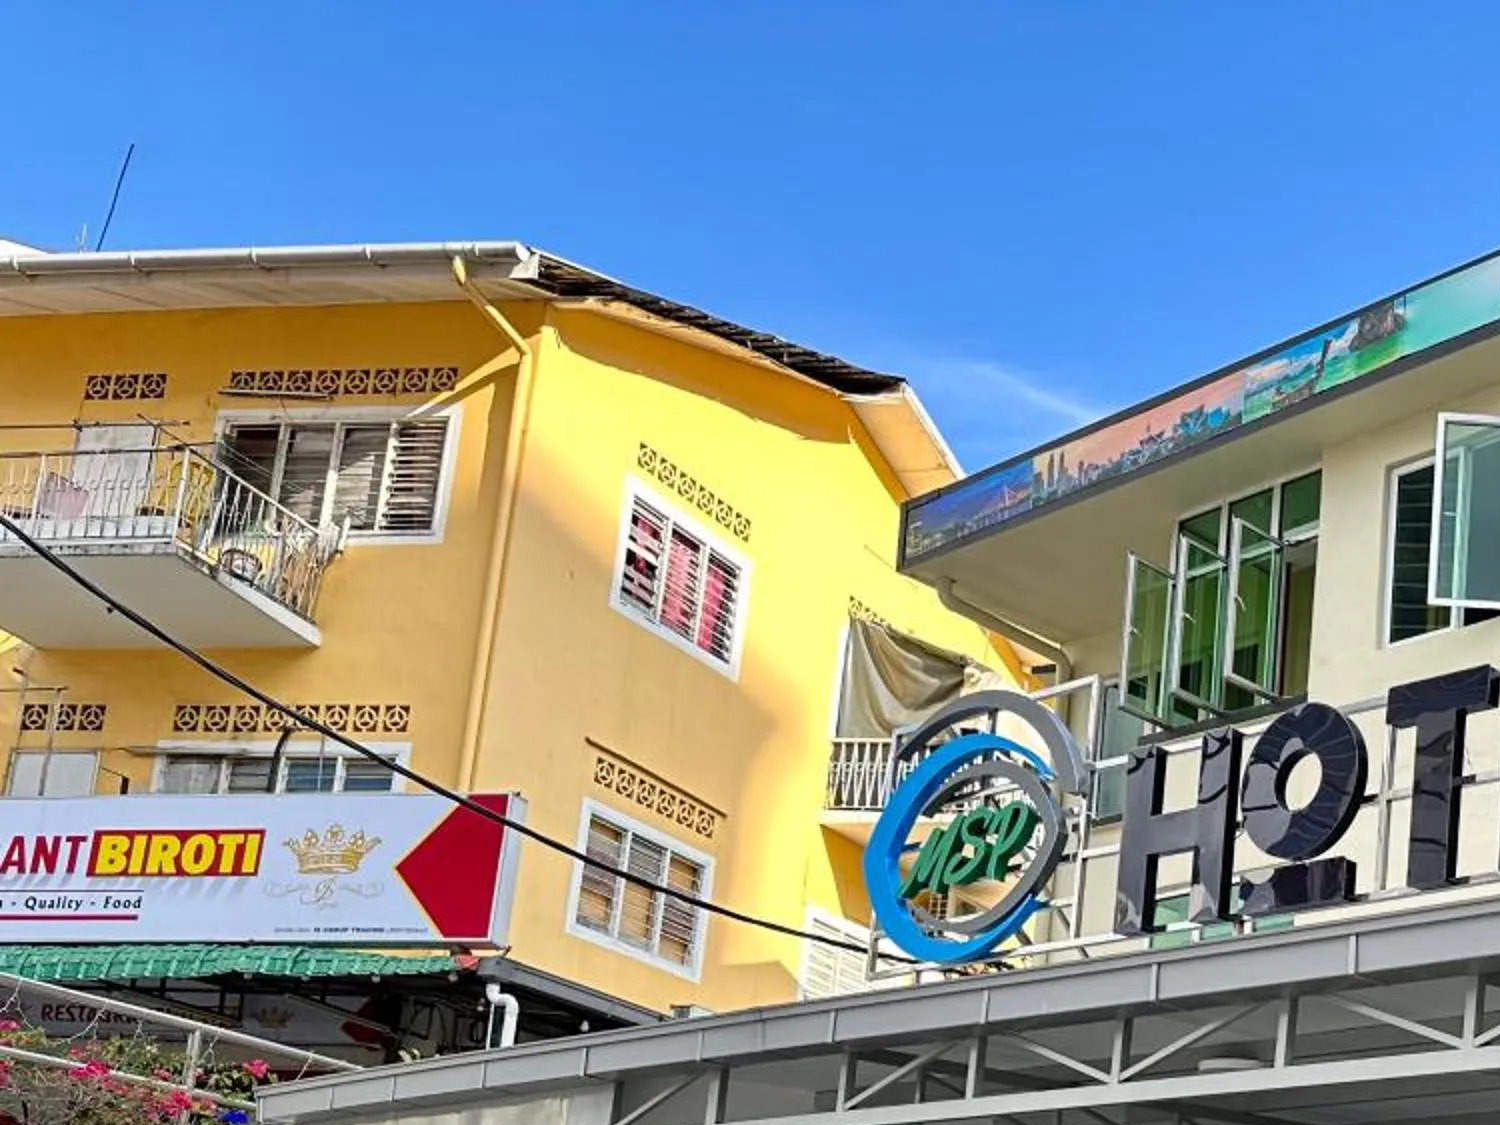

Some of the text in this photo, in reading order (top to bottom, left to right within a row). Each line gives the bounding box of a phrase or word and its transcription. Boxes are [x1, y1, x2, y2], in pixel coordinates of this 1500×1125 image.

[0, 832, 261, 875] ANT BIROTI
[898, 799, 1042, 899] MSP
[25, 895, 142, 911] Quality Food
